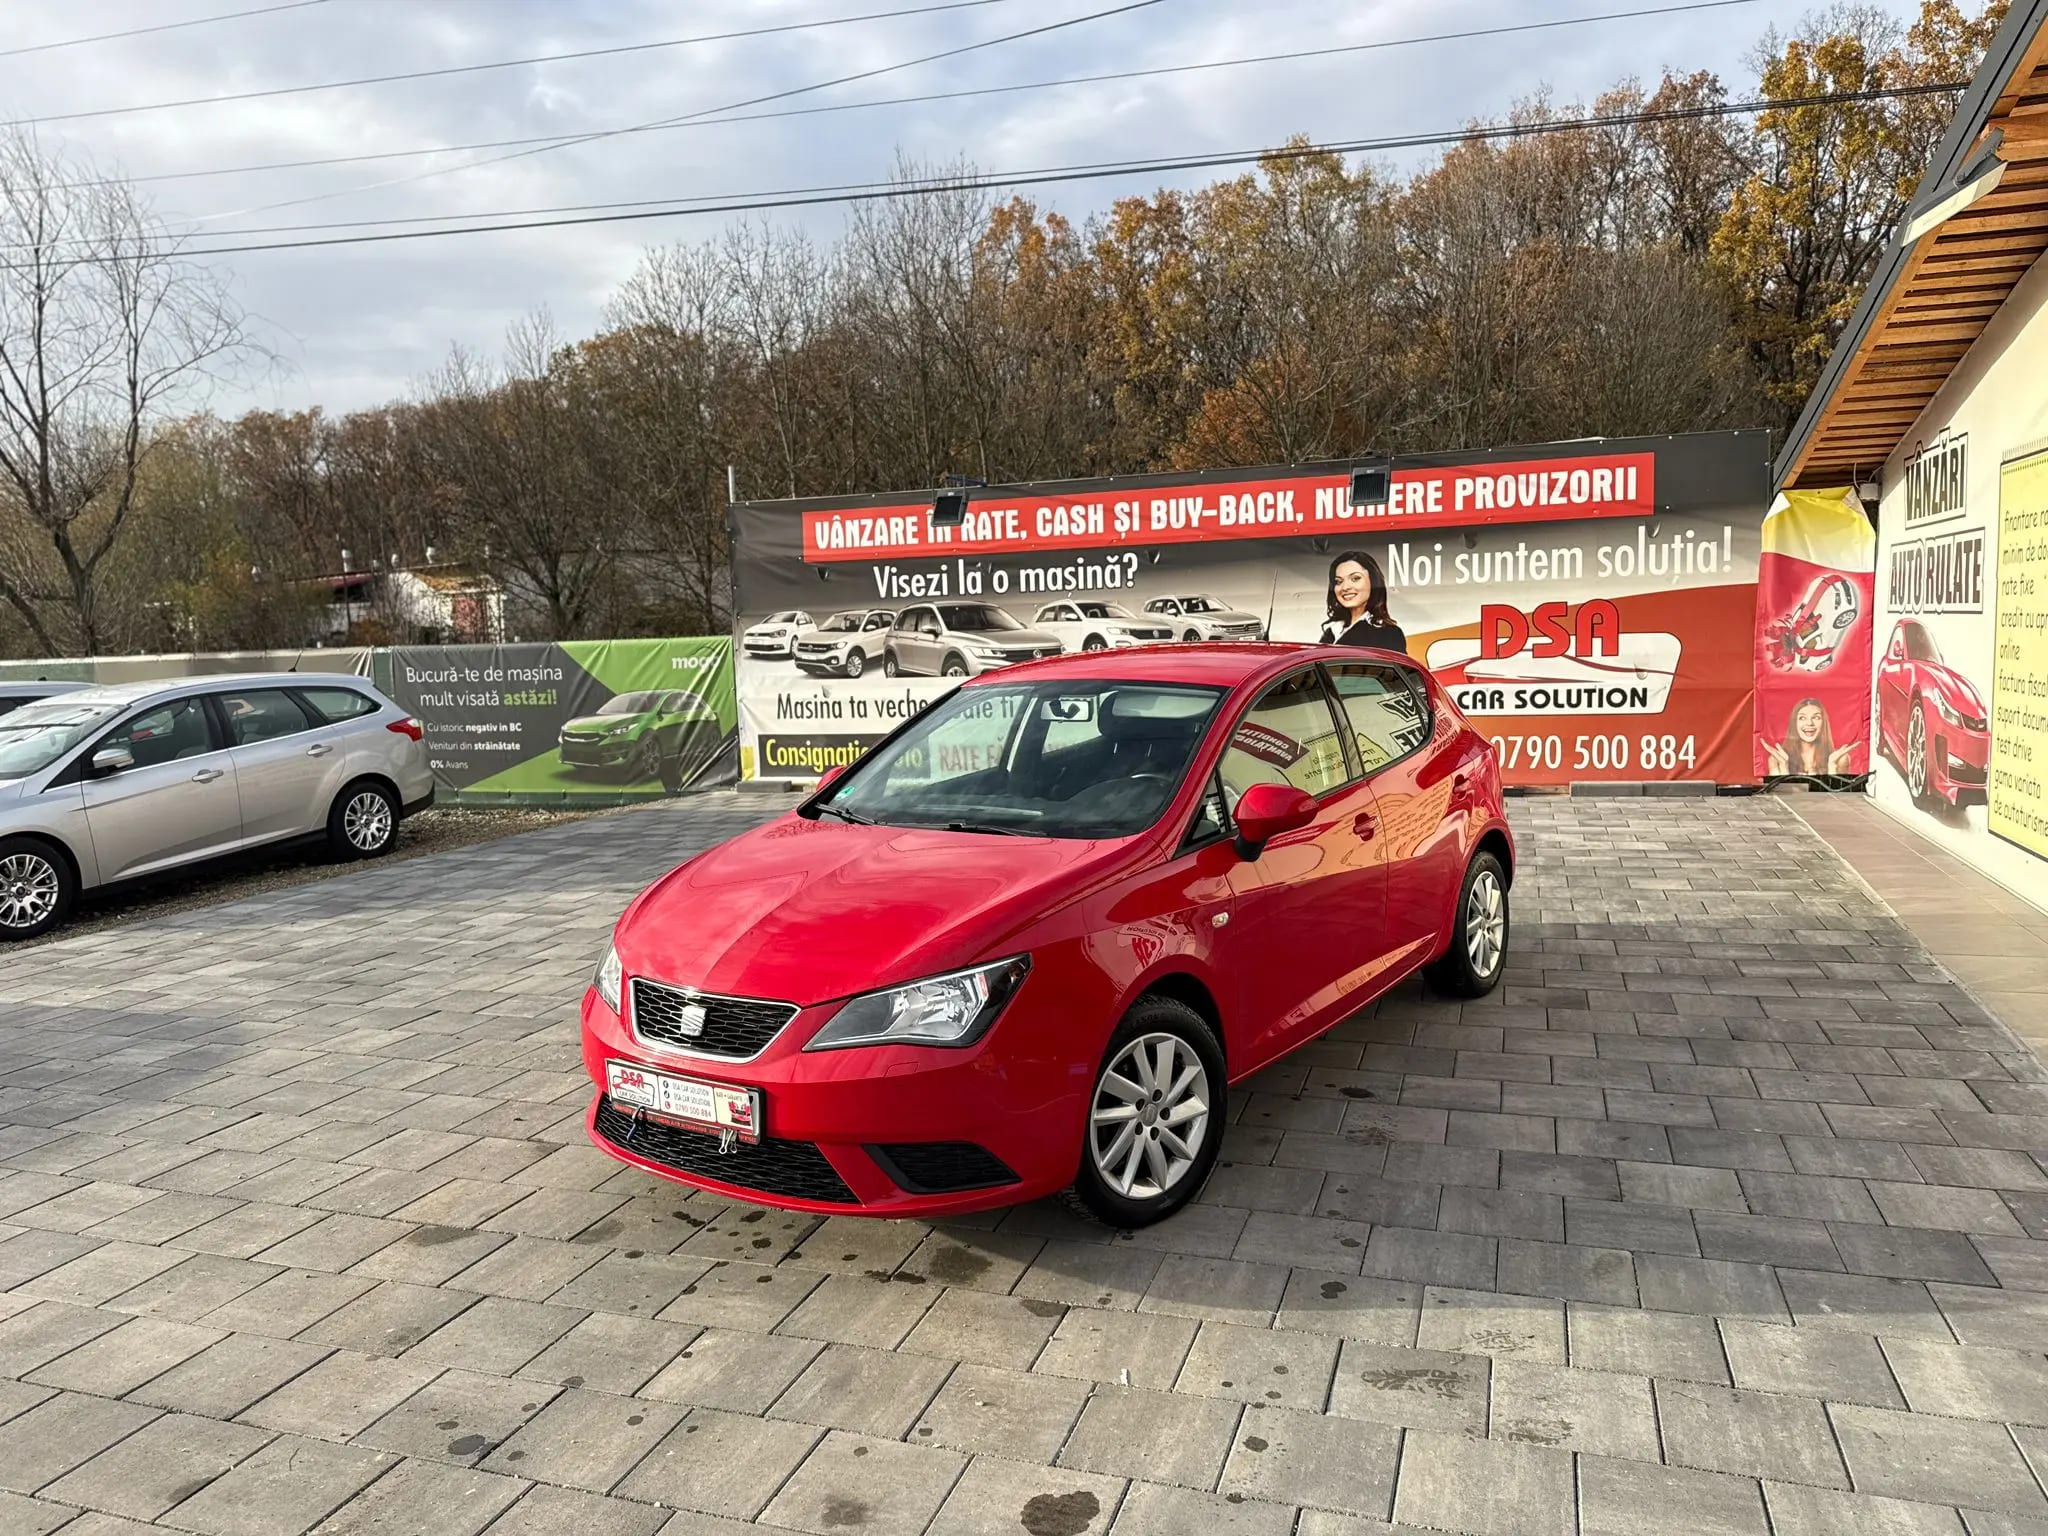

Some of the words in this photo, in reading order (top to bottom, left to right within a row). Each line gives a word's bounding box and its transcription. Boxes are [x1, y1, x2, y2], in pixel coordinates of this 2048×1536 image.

[1906, 438, 1966, 521] VÂNZĂRI
[815, 515, 919, 550] VÂNZARE
[961, 509, 1027, 541] RATE,
[1036, 503, 1104, 538] CASH
[1113, 501, 1140, 540] ȘI
[1151, 490, 1304, 531] BUY-BACK,
[1454, 466, 1637, 511] PROVIZORII
[1388, 543, 1442, 587] Noi
[1455, 542, 1583, 584] suntem
[1597, 525, 1732, 585] soluția!
[2026, 539, 2036, 561] de
[873, 563, 949, 598] Visezi
[958, 559, 983, 595] la
[992, 569, 1009, 594] o
[1020, 552, 1139, 600] mașină?
[1890, 547, 1923, 606] AUTO
[1926, 538, 1982, 605] RULATE
[2002, 579, 2018, 597] rate
[2020, 573, 2035, 596] fixe
[1481, 598, 1619, 660] DSA
[2001, 606, 2023, 629] credit
[2025, 612, 2034, 629] cu
[406, 666, 480, 683] Bucură-te
[484, 665, 503, 682] de
[508, 664, 563, 685] mașina
[420, 690, 455, 706] mult
[457, 689, 499, 706] visată
[504, 688, 558, 706] astăzi!
[849, 695, 868, 718] ta
[1457, 689, 1504, 710] CAR
[1514, 687, 1648, 709] SOLUTION
[427, 723, 439, 732] Cu
[440, 722, 465, 732] istoric
[466, 722, 497, 734] negativ
[509, 722, 523, 732] BC
[428, 742, 459, 751] Venituri
[460, 741, 473, 750] din
[1490, 735, 1562, 770] 0790
[1573, 735, 1629, 770] 500
[1639, 735, 1697, 770] 884
[1997, 732, 2012, 755] test
[2013, 736, 2033, 762] drive
[430, 760, 444, 769] 0%
[445, 760, 469, 770] Avans
[939, 744, 980, 773] RATE
[1994, 792, 2002, 816] de
[621, 1069, 645, 1089] DSA
